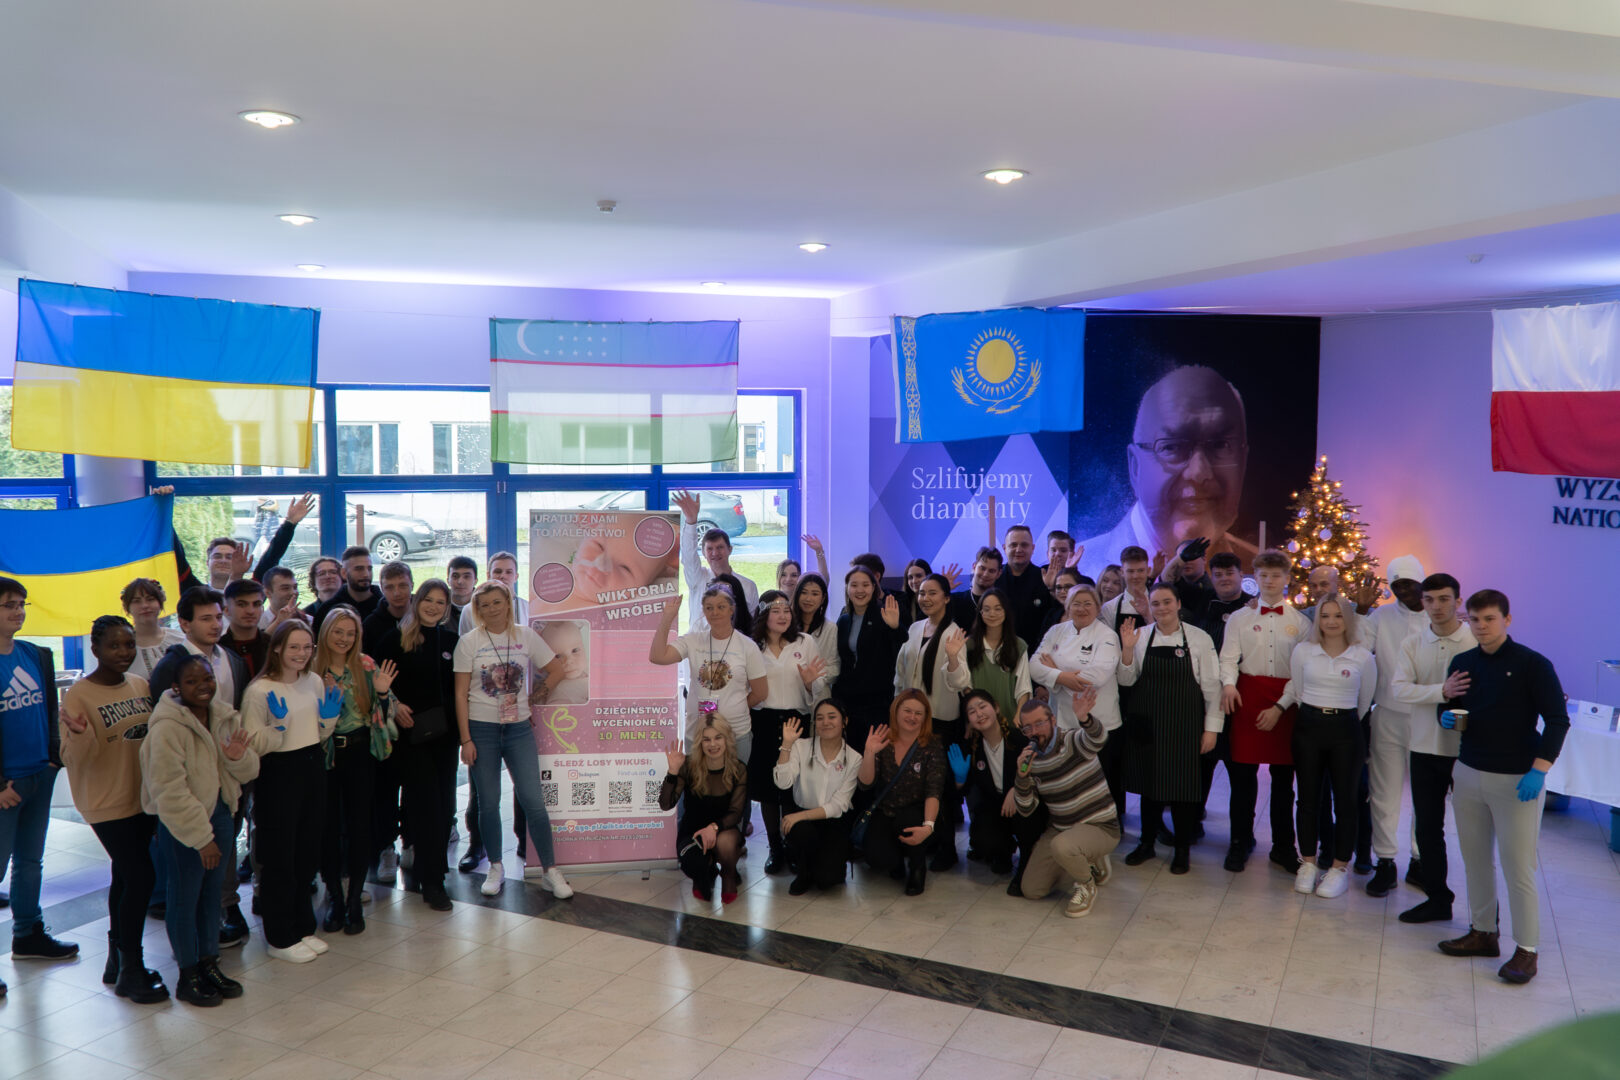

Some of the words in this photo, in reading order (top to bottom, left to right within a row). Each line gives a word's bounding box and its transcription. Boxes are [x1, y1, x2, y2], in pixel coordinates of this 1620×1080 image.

[911, 466, 1033, 496] Szlifujemy
[911, 495, 1032, 526] diamenty
[1552, 506, 1620, 528] NATIO
[535, 514, 578, 523] URATUJ
[581, 514, 588, 523] Z
[590, 514, 618, 524] NAMI
[535, 528, 550, 537] TO
[596, 582, 676, 604] WIKTORIA
[606, 601, 666, 620] WRÓBE
[592, 719, 656, 727] WYCENIONE
[599, 731, 613, 740] 10
[620, 731, 646, 740] MLN
[586, 759, 612, 767] LOSY
[615, 758, 653, 766] WIKUSI:
